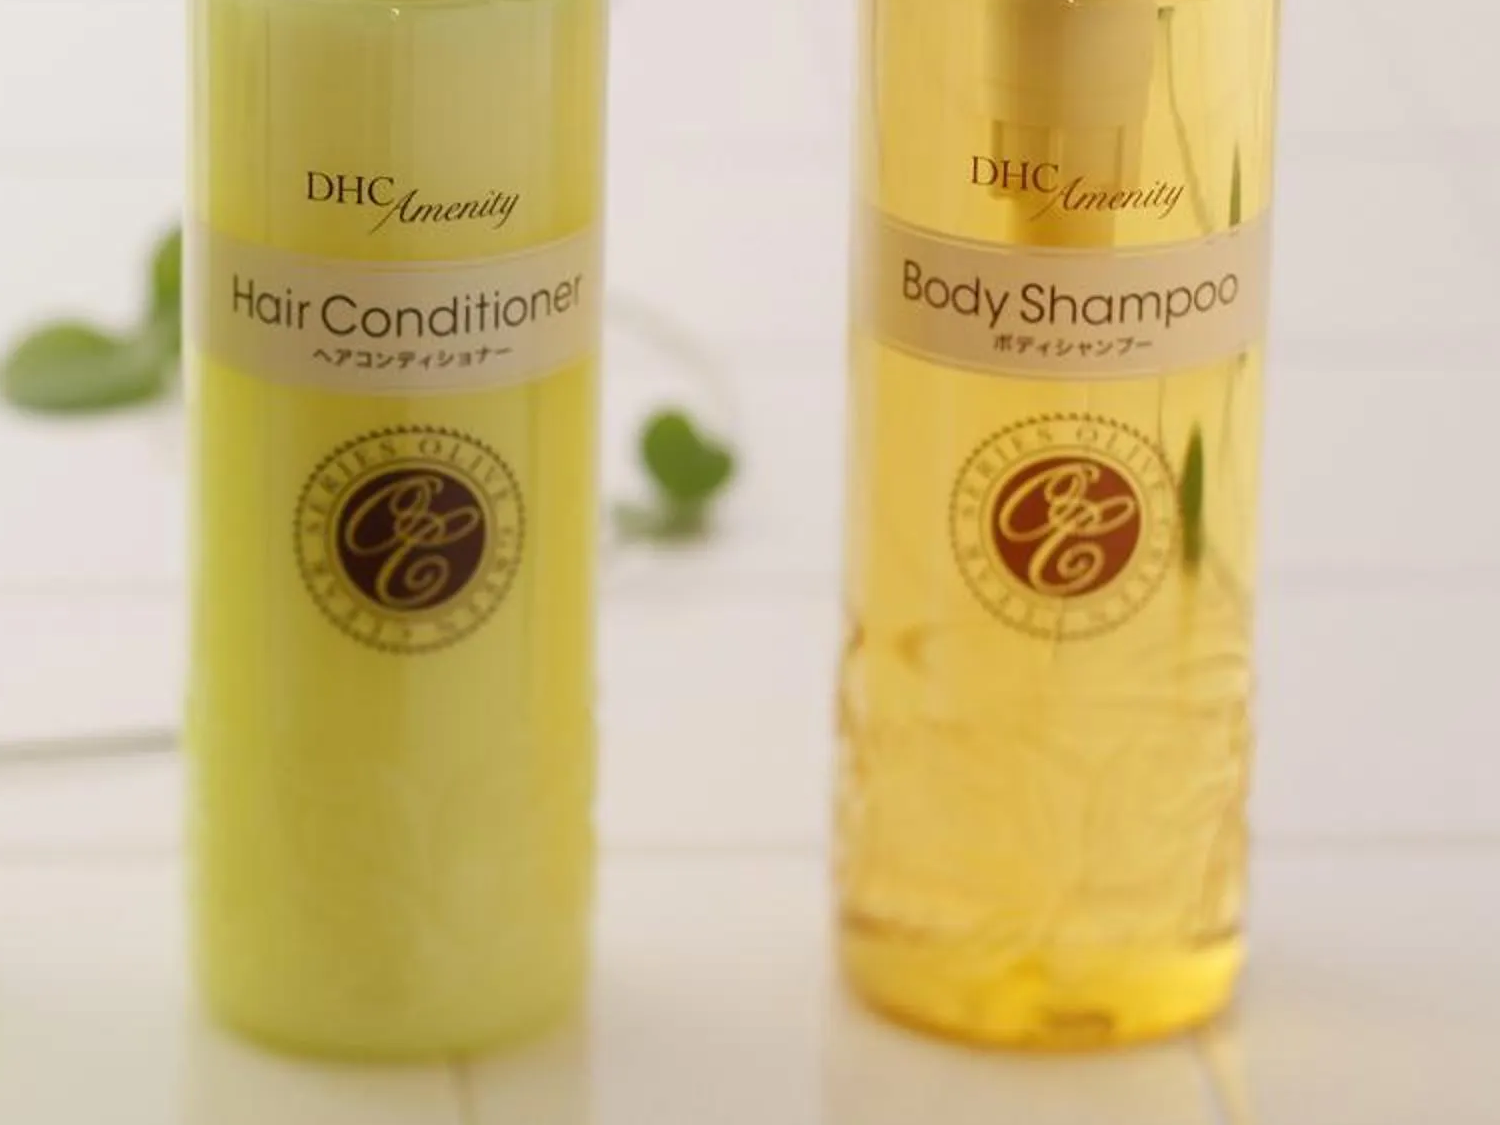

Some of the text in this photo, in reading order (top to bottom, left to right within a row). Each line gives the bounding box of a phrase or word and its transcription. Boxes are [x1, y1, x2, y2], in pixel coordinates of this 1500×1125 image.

[307, 171, 521, 236] DHC Amenity
[971, 155, 1186, 222] DHC Amenity
[232, 274, 583, 338] Hair Conditioner
[902, 259, 1240, 328] Body Shampoo
[312, 347, 514, 369] ヘアコンディショナー
